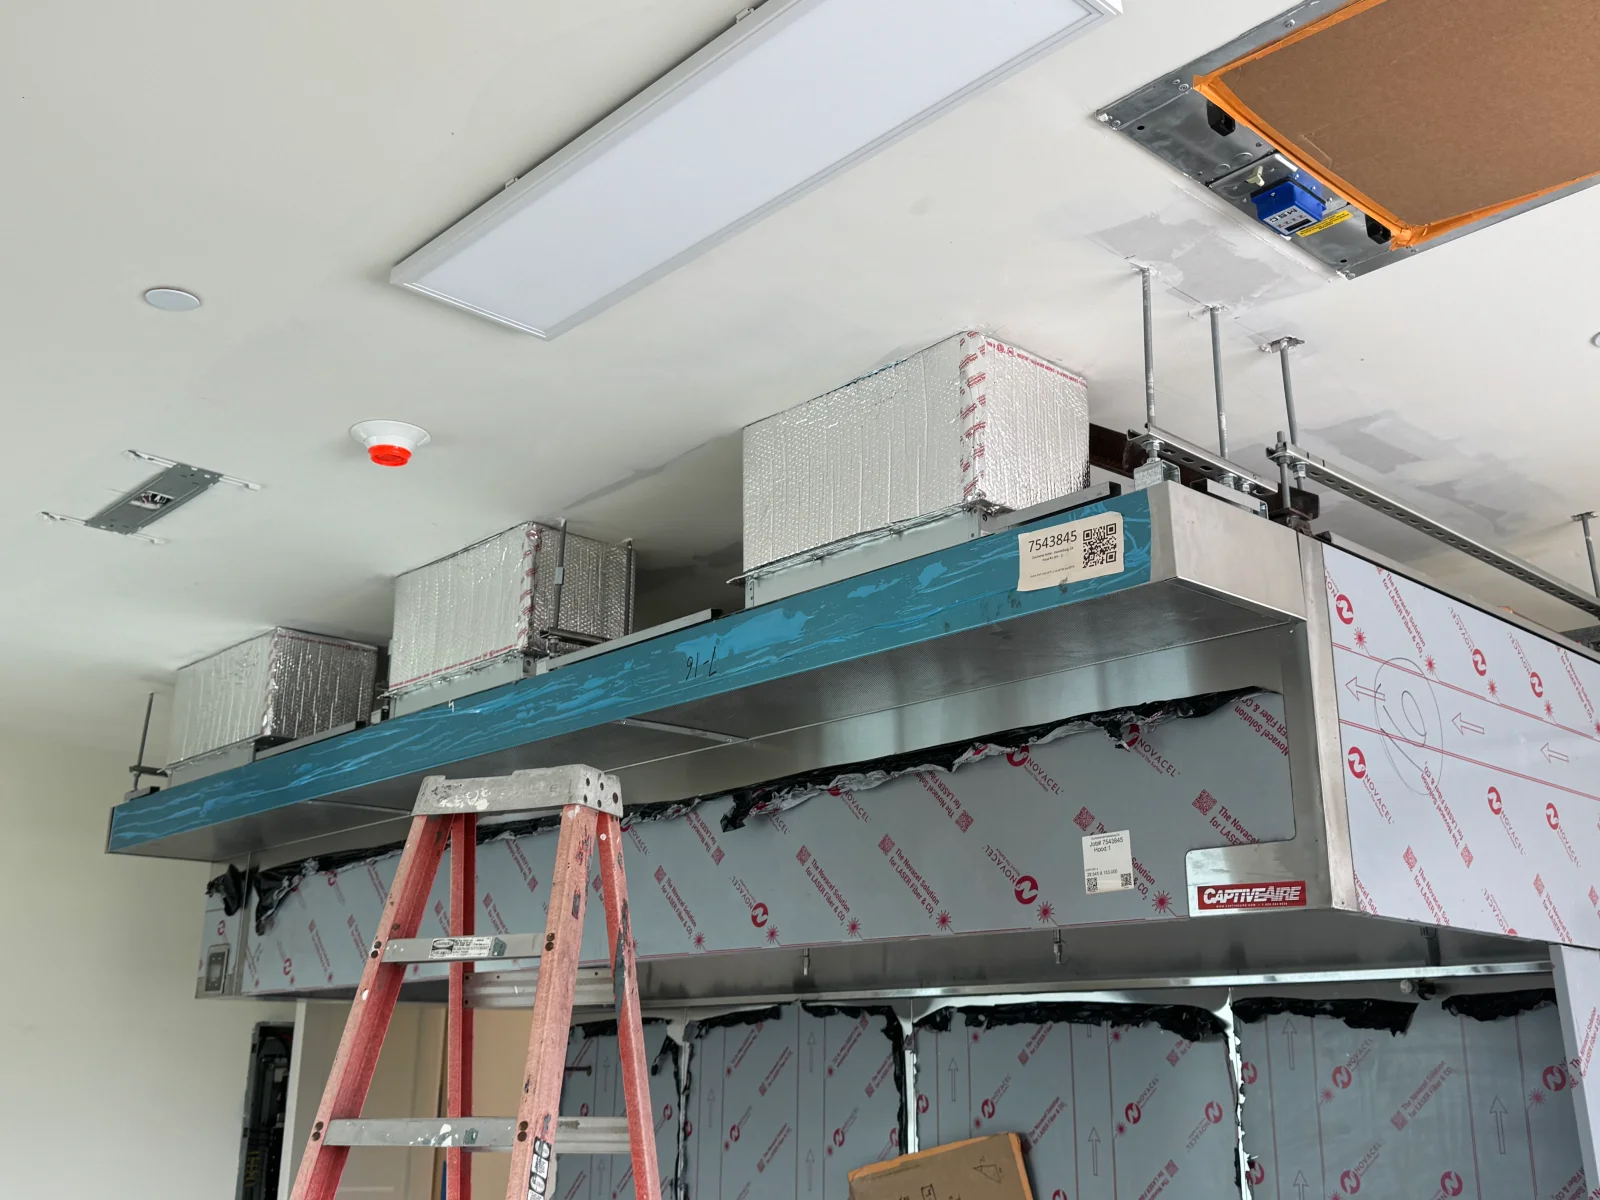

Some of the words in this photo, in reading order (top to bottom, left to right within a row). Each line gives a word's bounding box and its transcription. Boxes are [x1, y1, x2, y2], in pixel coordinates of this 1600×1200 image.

[1028, 529, 1077, 553] 7543845
[1388, 590, 1403, 616] LASER
[1393, 586, 1410, 617] Novacel
[1409, 616, 1426, 648] Solution
[1234, 705, 1263, 733] Solution
[1259, 708, 1279, 728] Fiber
[1138, 739, 1177, 778] NOVACEL
[937, 780, 954, 801] LASER
[1026, 758, 1061, 795] NOVACEL
[843, 790, 869, 823] NOVACEL
[926, 785, 947, 808] Novacel
[1218, 805, 1231, 822] The
[1364, 773, 1392, 825] NOVACEL
[1209, 816, 1221, 830] for
[1501, 810, 1525, 856] NOVACEL
[889, 856, 897, 867] for
[895, 864, 911, 886] LASER
[909, 882, 922, 900] Fiber
[895, 847, 905, 861] The
[903, 858, 923, 882] Novacel
[920, 880, 940, 906] Solution
[986, 844, 1017, 885] NOVACEL
[1131, 857, 1156, 885] Solution
[731, 875, 753, 909] NOVACEL
[811, 858, 820, 871] The
[818, 868, 835, 891] Novacel
[832, 888, 850, 913] Solution
[811, 874, 825, 895] LASER
[823, 891, 834, 907] Fiber
[1203, 886, 1302, 904] CAPTIVEAIRE
[1413, 874, 1421, 888] for
[1420, 886, 1435, 914] LASER
[1419, 865, 1427, 883] The
[1425, 881, 1443, 912] Novacel
[1483, 887, 1508, 933] NOVACEL
[1354, 1142, 1382, 1176] NOVACEL
